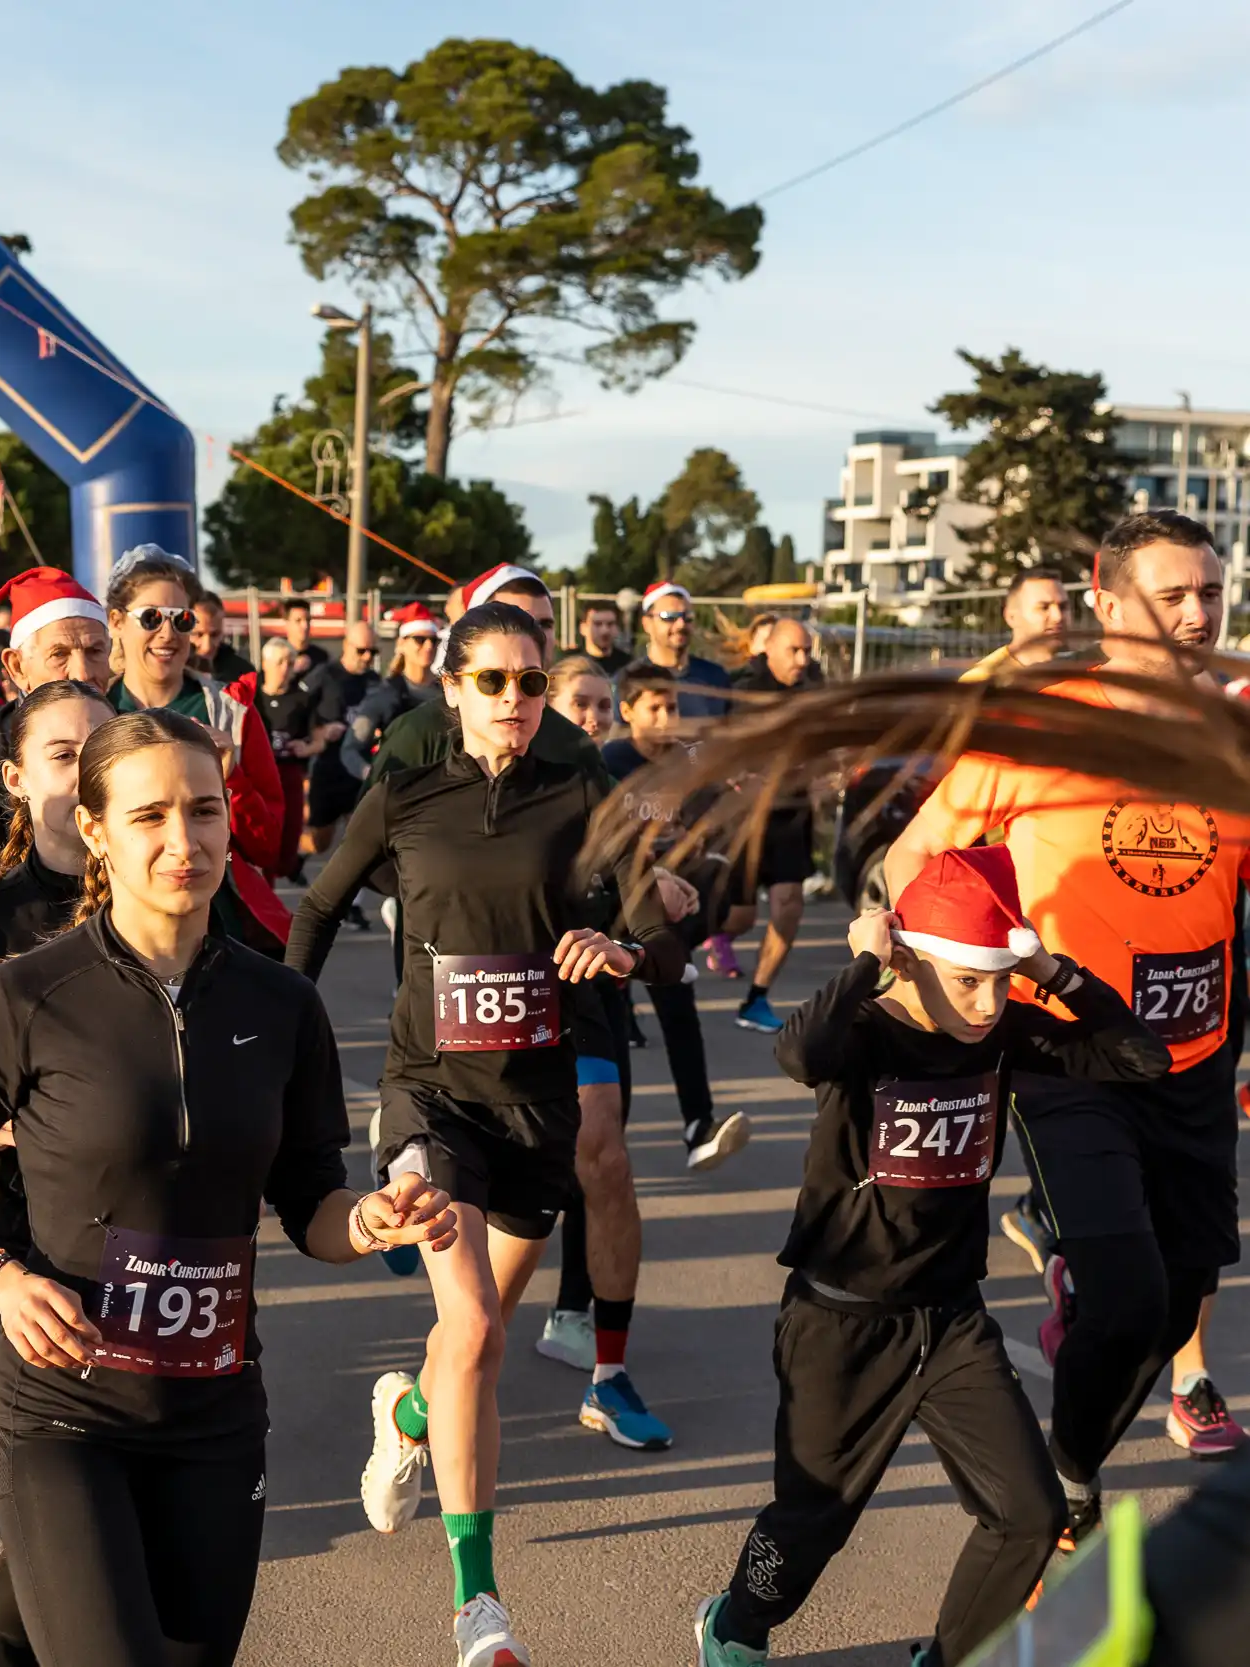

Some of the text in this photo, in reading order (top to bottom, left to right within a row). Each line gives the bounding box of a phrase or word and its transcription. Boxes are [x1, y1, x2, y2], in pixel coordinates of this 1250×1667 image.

[449, 969, 545, 984] ZADAR CHRISTMAS RUN
[451, 986, 527, 1025] 185
[1145, 977, 1210, 1020] 278
[894, 1099, 928, 1113] ZADAR
[928, 1098, 976, 1112] CHRISTMAS
[889, 1113, 976, 1158] 247
[124, 1255, 241, 1279] ZADAR CHRISTMAS RUN
[125, 1281, 220, 1338] 193
